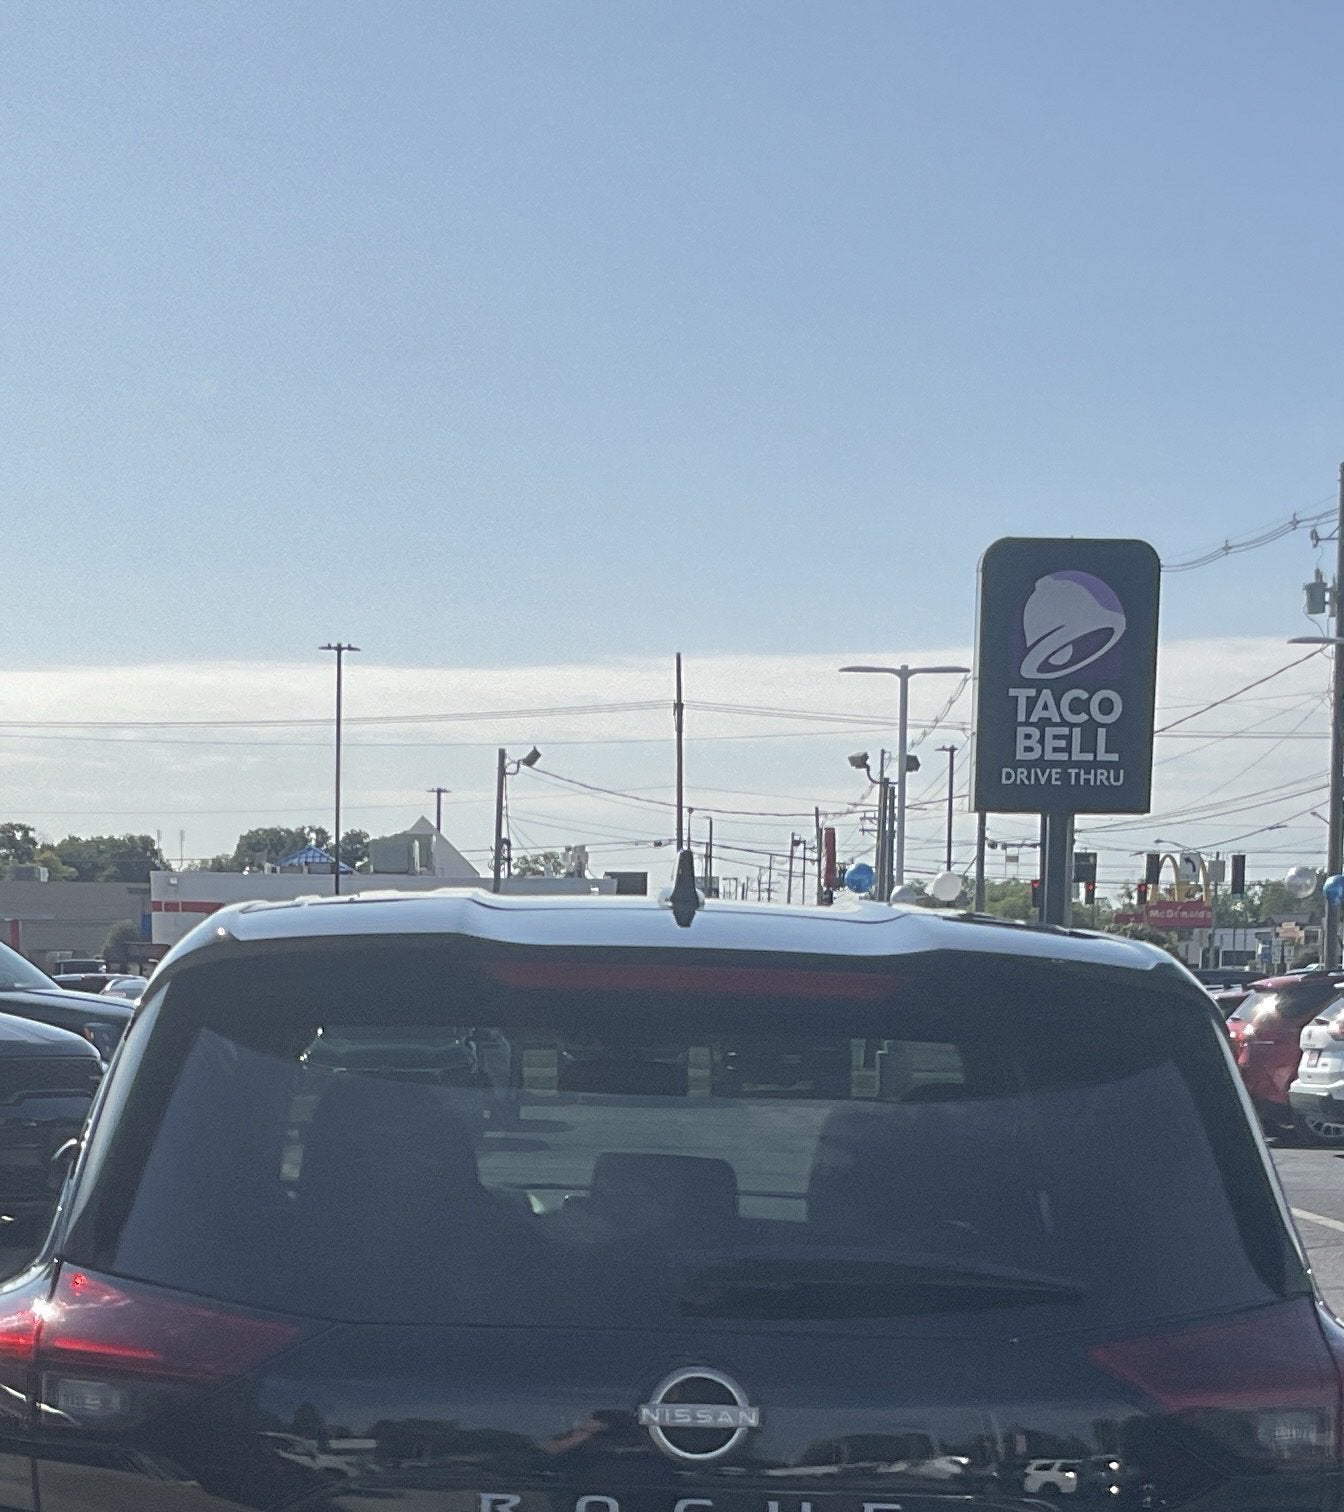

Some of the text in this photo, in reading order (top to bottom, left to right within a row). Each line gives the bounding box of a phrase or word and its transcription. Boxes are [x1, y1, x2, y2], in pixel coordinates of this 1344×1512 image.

[1008, 688, 1123, 724] TACO
[1015, 726, 1119, 761] BELL
[1001, 767, 1125, 786] DRIVE THRU
[641, 1407, 756, 1425] NISSAN
